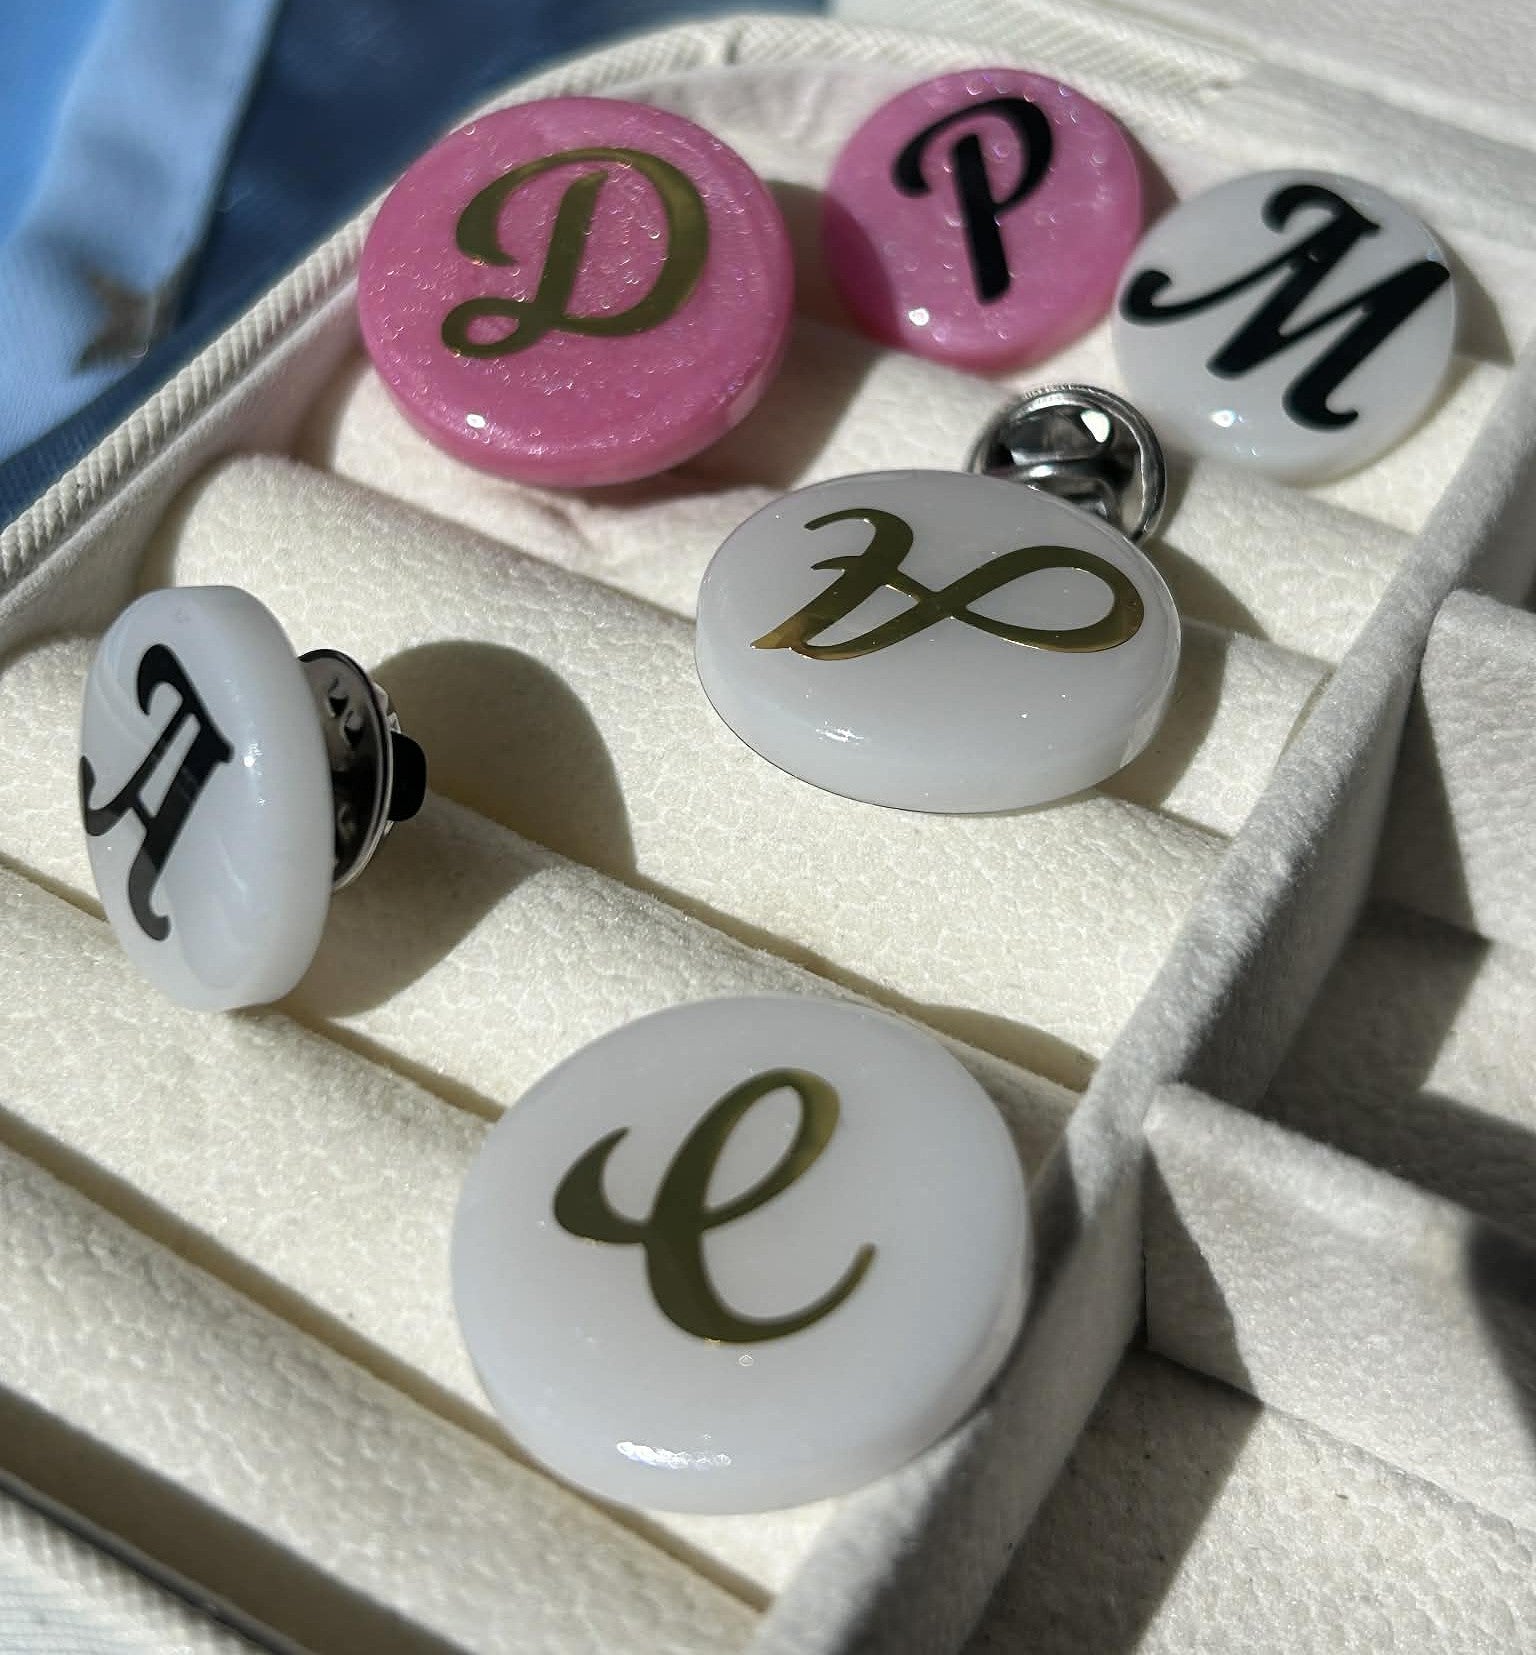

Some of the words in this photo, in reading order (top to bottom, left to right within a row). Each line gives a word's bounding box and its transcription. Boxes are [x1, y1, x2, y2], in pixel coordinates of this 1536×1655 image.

[440, 146, 711, 359] D
[890, 95, 1056, 305] P
[1118, 182, 1452, 431] M
[79, 643, 235, 941] A
